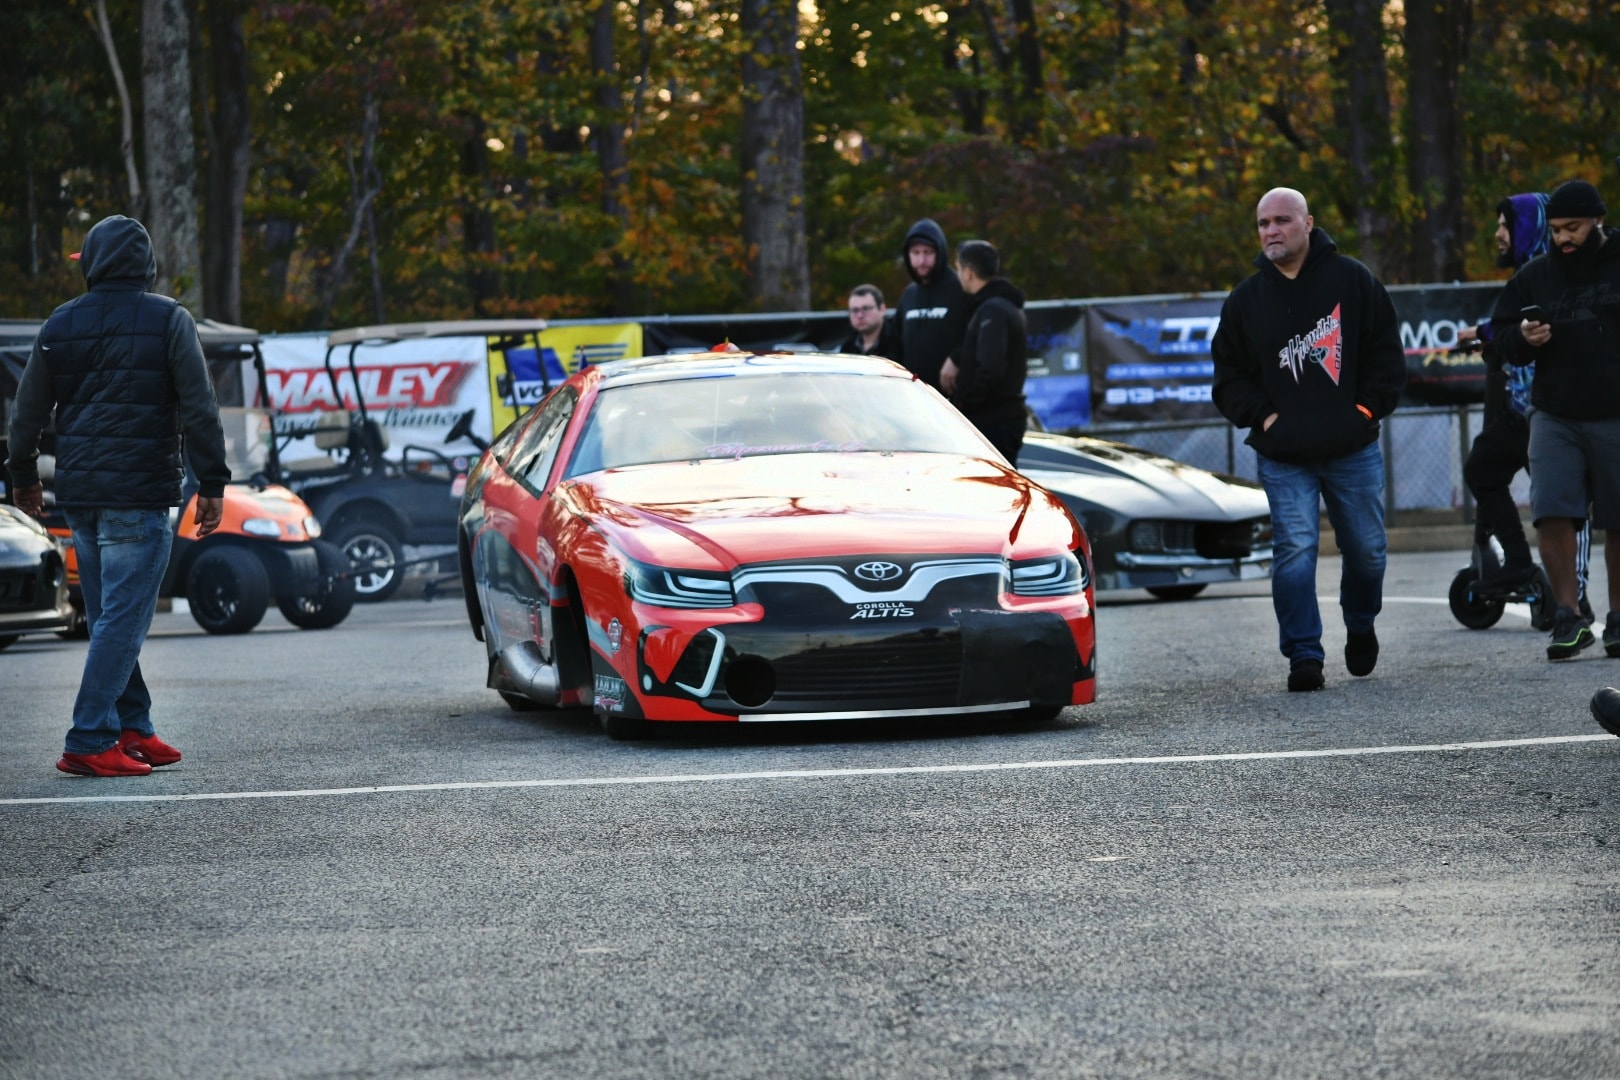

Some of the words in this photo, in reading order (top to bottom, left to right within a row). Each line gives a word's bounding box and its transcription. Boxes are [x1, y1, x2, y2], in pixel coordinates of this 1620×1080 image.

[264, 364, 454, 410] MANLEY
[856, 602, 905, 610] COROLLA
[849, 607, 915, 619] ALTIS
